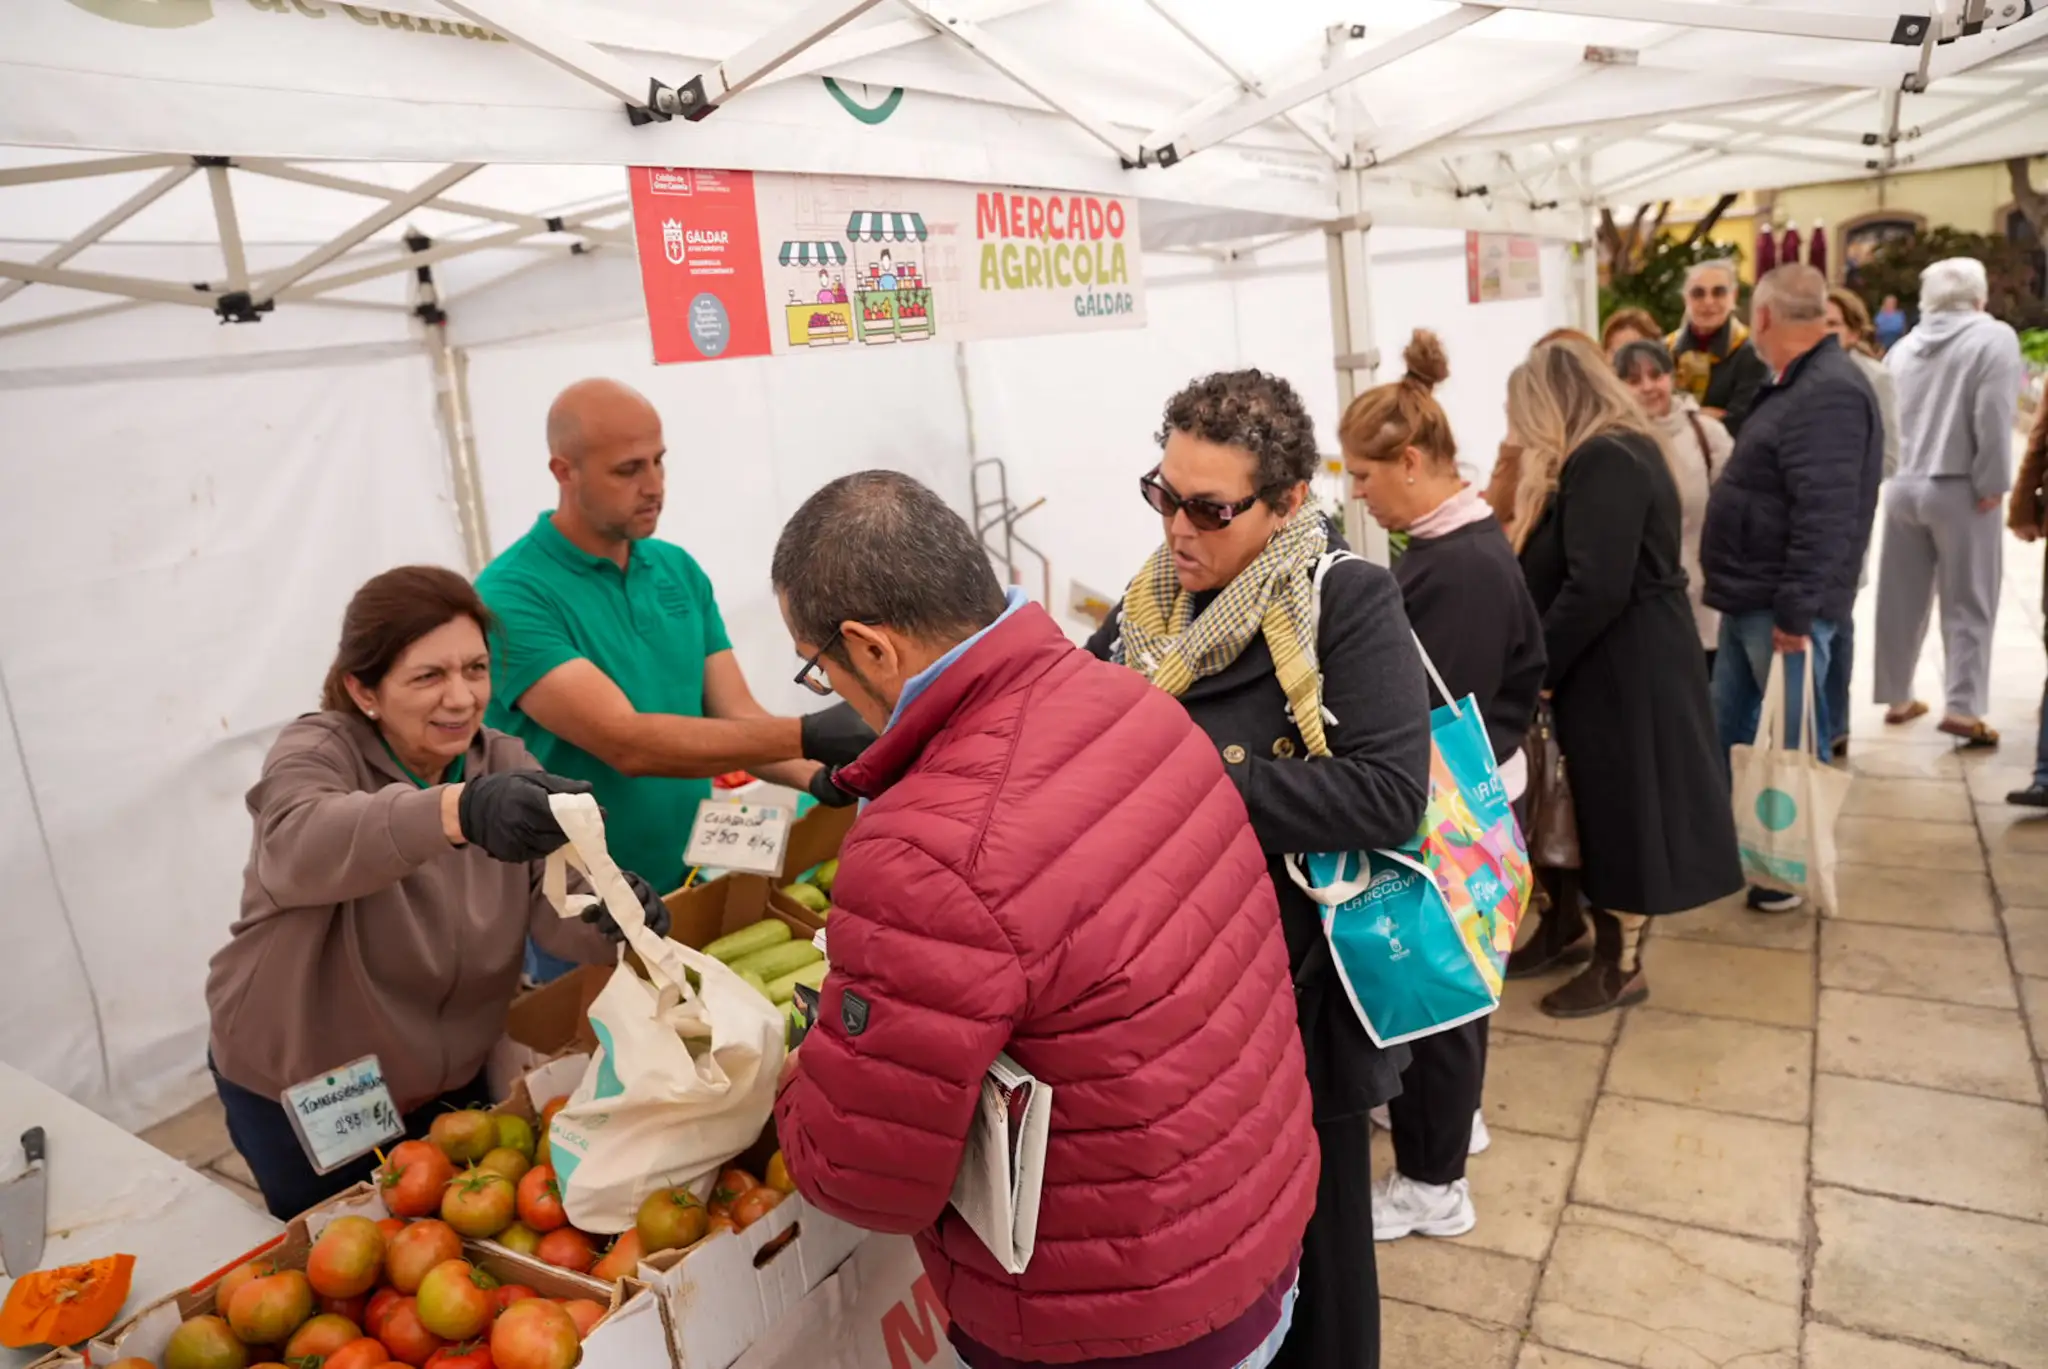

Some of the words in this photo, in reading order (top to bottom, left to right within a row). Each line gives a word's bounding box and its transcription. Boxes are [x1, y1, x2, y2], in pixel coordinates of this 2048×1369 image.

[976, 191, 1126, 241] MERCADO
[979, 225, 1128, 291] AGRÍCOLA
[1073, 284, 1134, 318] GÁLDAR
[1343, 897, 1362, 912] LA
